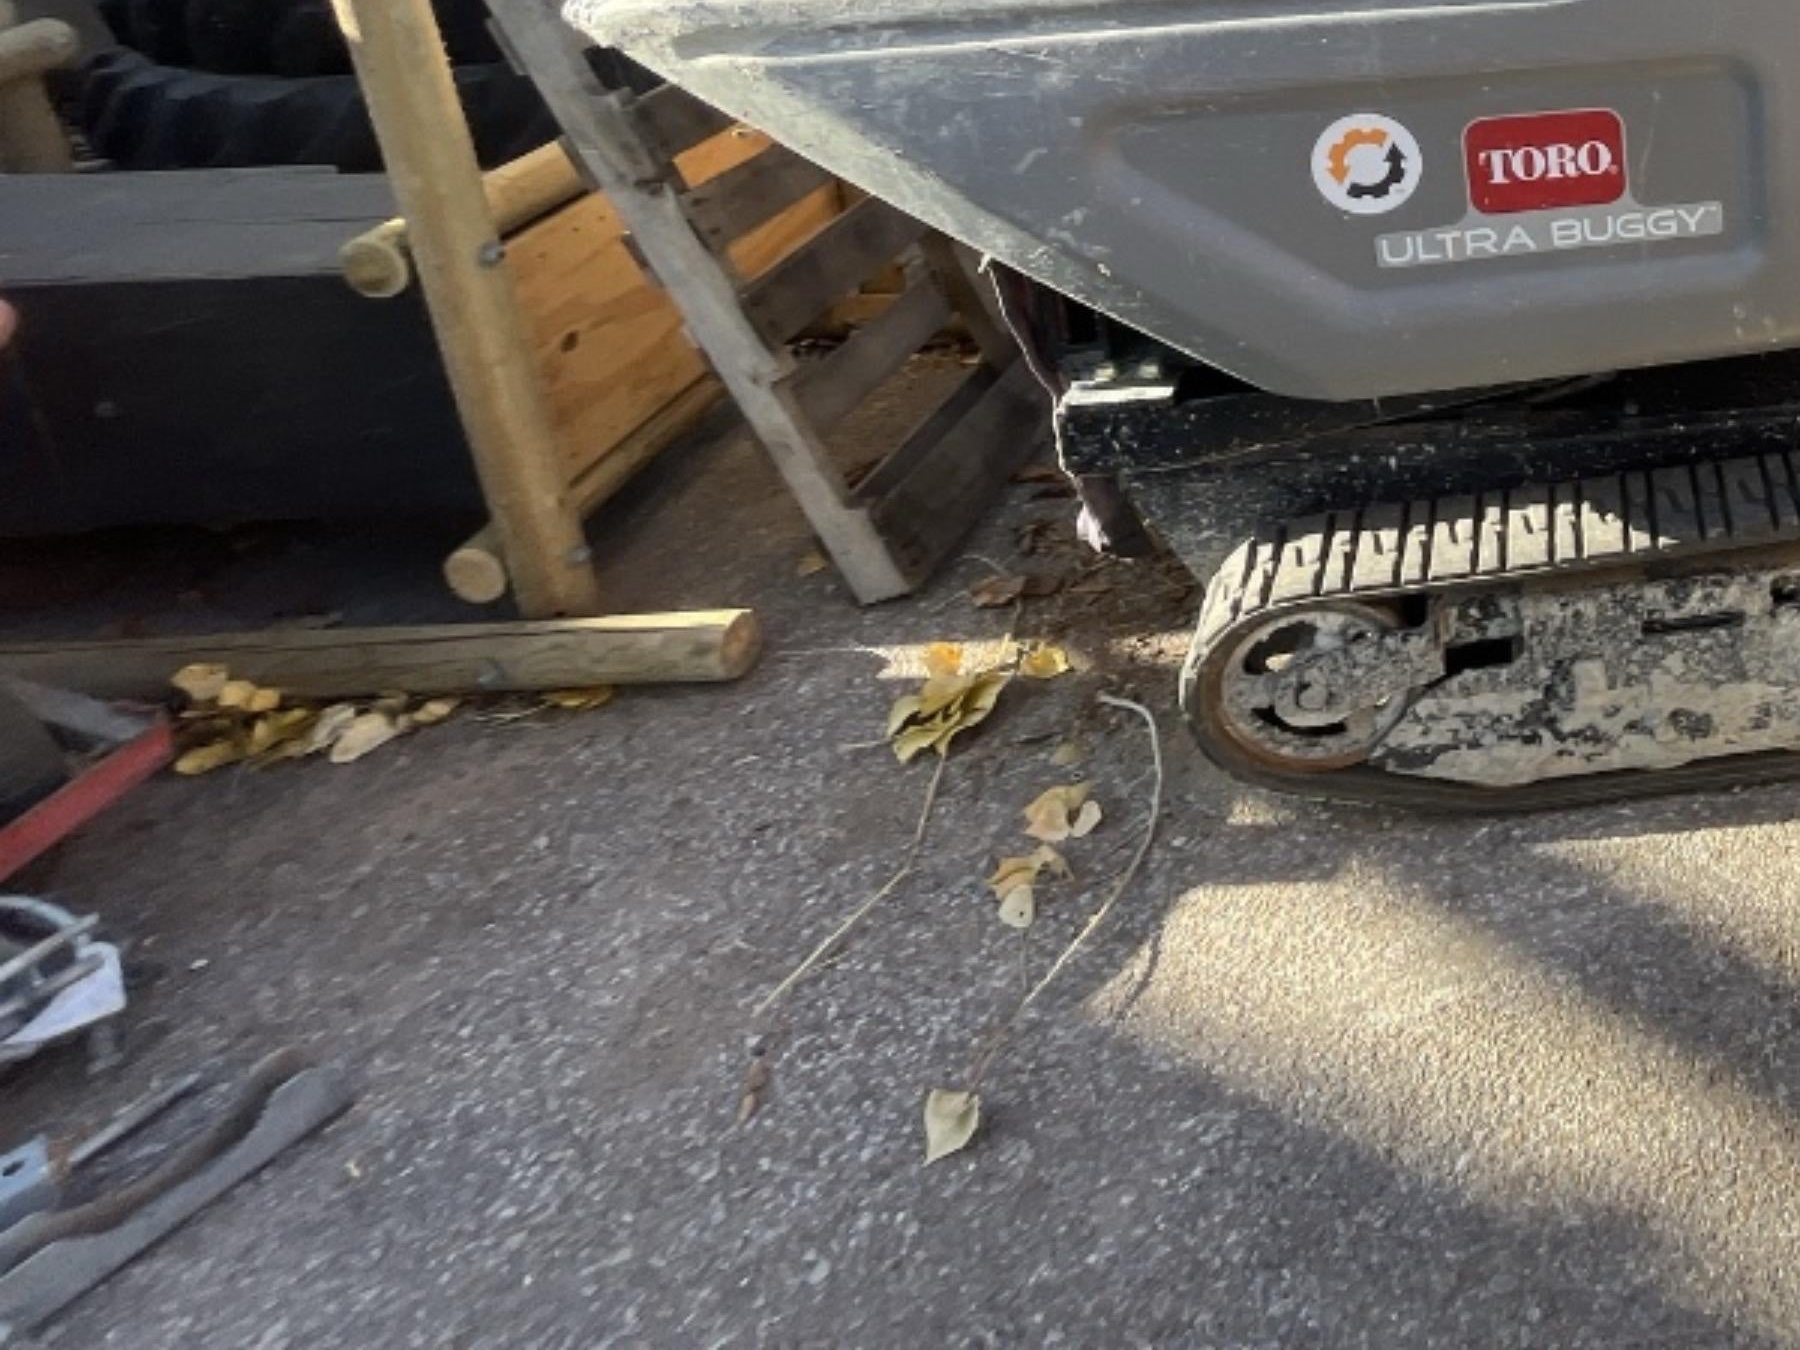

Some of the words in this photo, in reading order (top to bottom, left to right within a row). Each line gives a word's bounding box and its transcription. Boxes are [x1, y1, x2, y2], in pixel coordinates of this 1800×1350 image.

[1479, 140, 1612, 184] TORO
[1381, 225, 1537, 263] ULTRA
[1552, 207, 1706, 248] BUGGY
